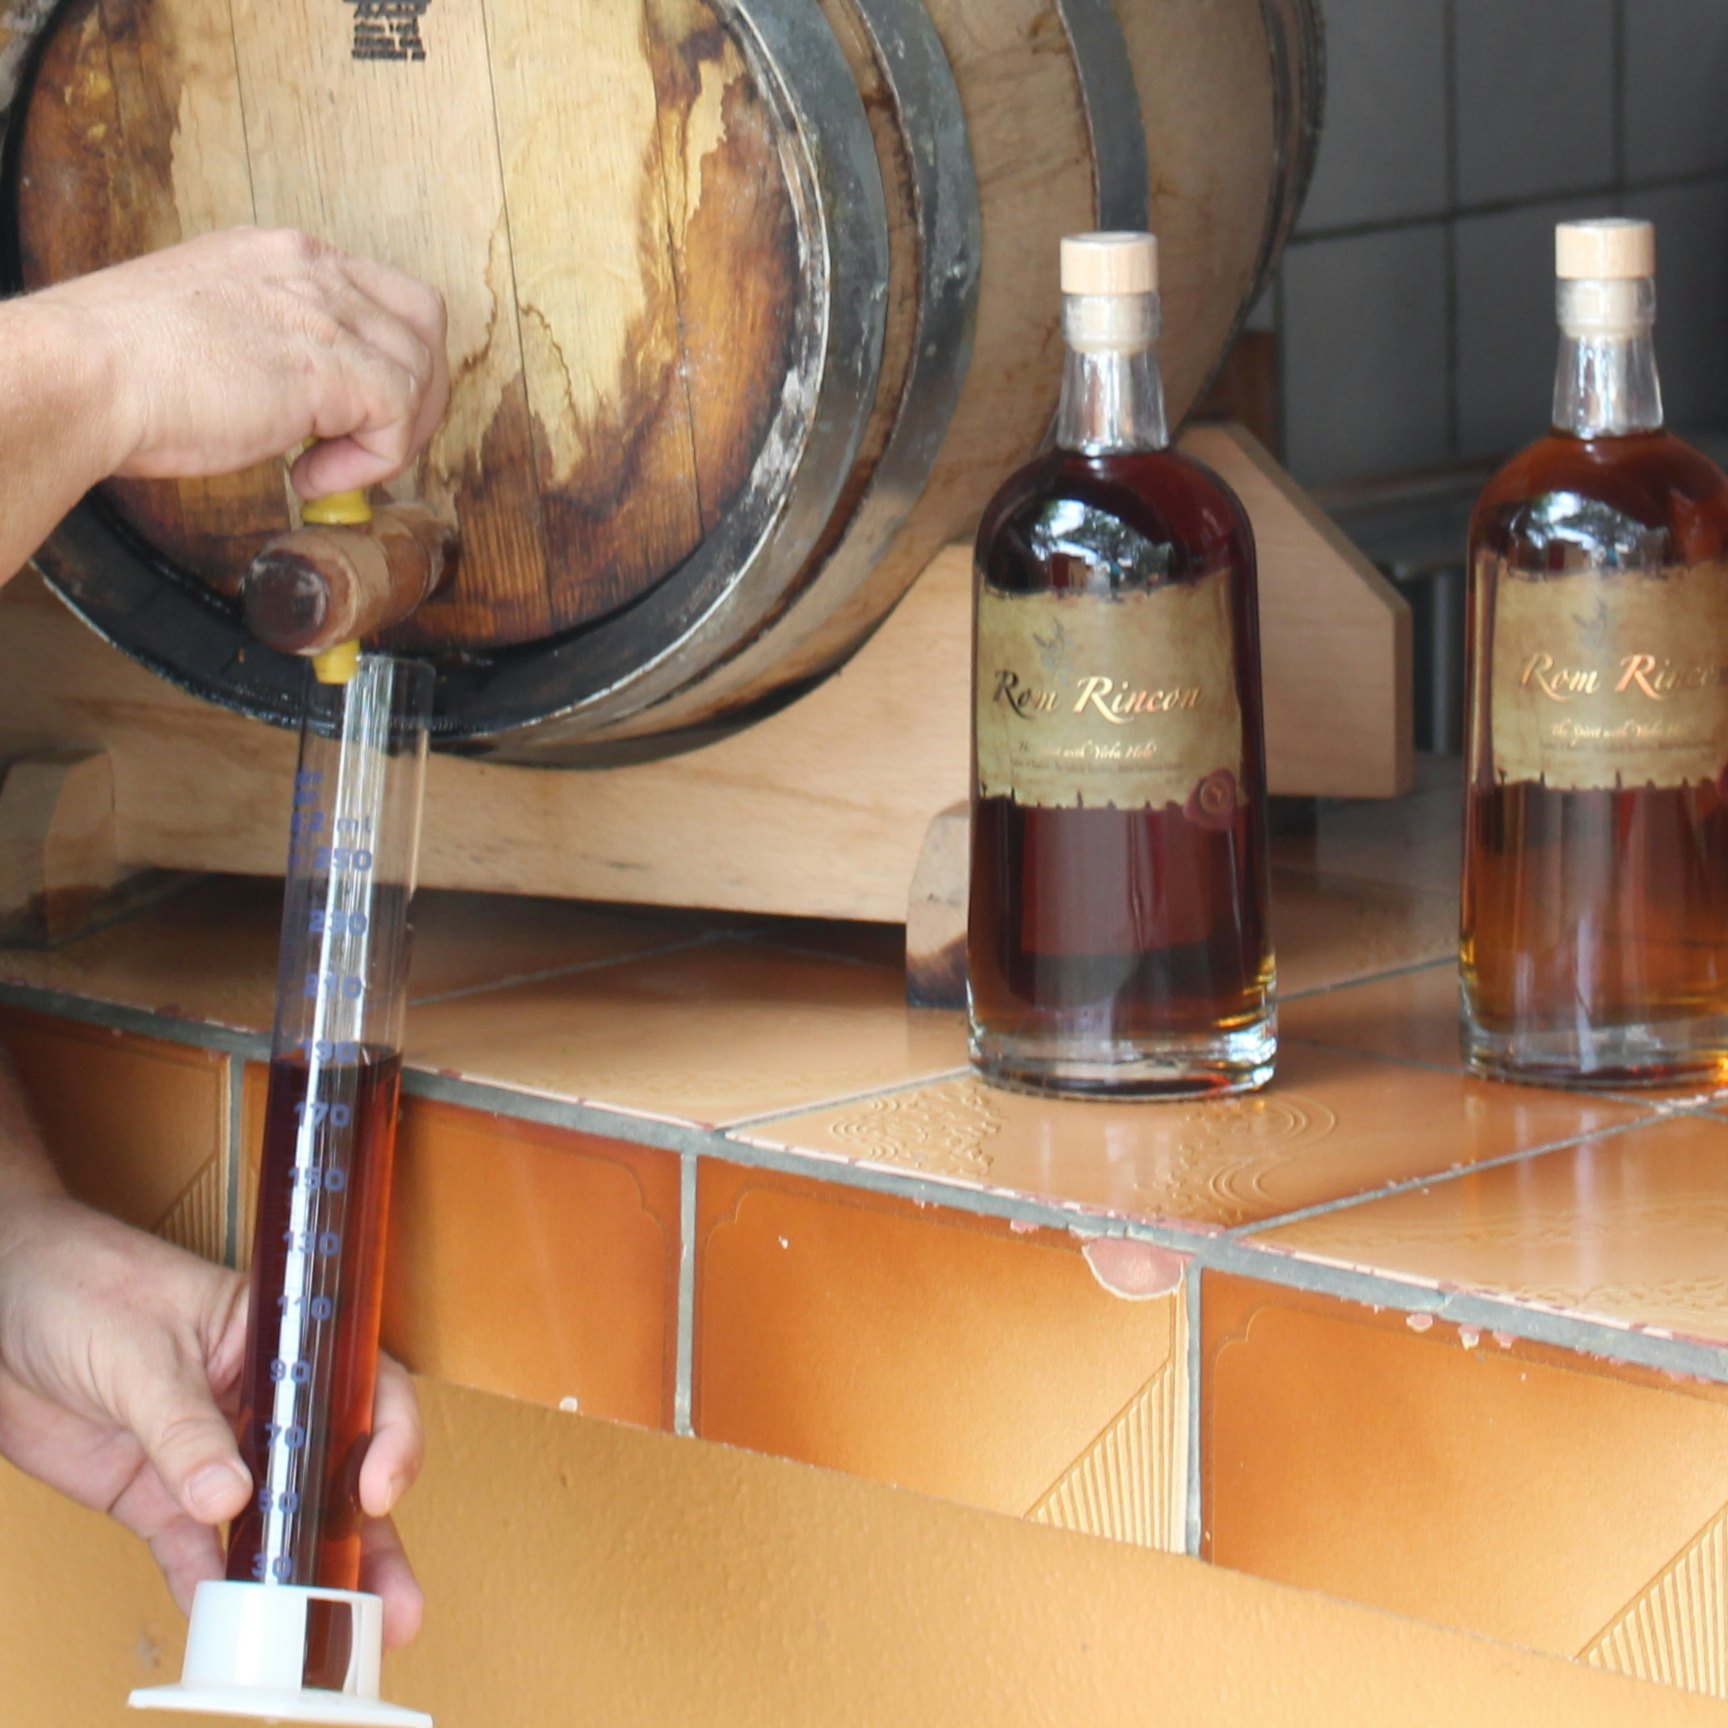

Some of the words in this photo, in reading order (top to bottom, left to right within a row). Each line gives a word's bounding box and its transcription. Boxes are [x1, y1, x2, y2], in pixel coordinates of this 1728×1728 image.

[1520, 652, 1602, 703] Rom
[992, 669, 1060, 721] Rom
[1073, 675, 1202, 725] Rincon
[303, 974, 363, 1000] 210
[301, 1038, 358, 1064] 190
[293, 1102, 351, 1128] 170
[288, 1166, 345, 1192] 150
[282, 1229, 340, 1256] 130
[277, 1294, 332, 1321] 110
[269, 1358, 311, 1384] 90
[264, 1422, 305, 1449] 70
[257, 1486, 299, 1514] 50
[251, 1552, 293, 1580] 30
